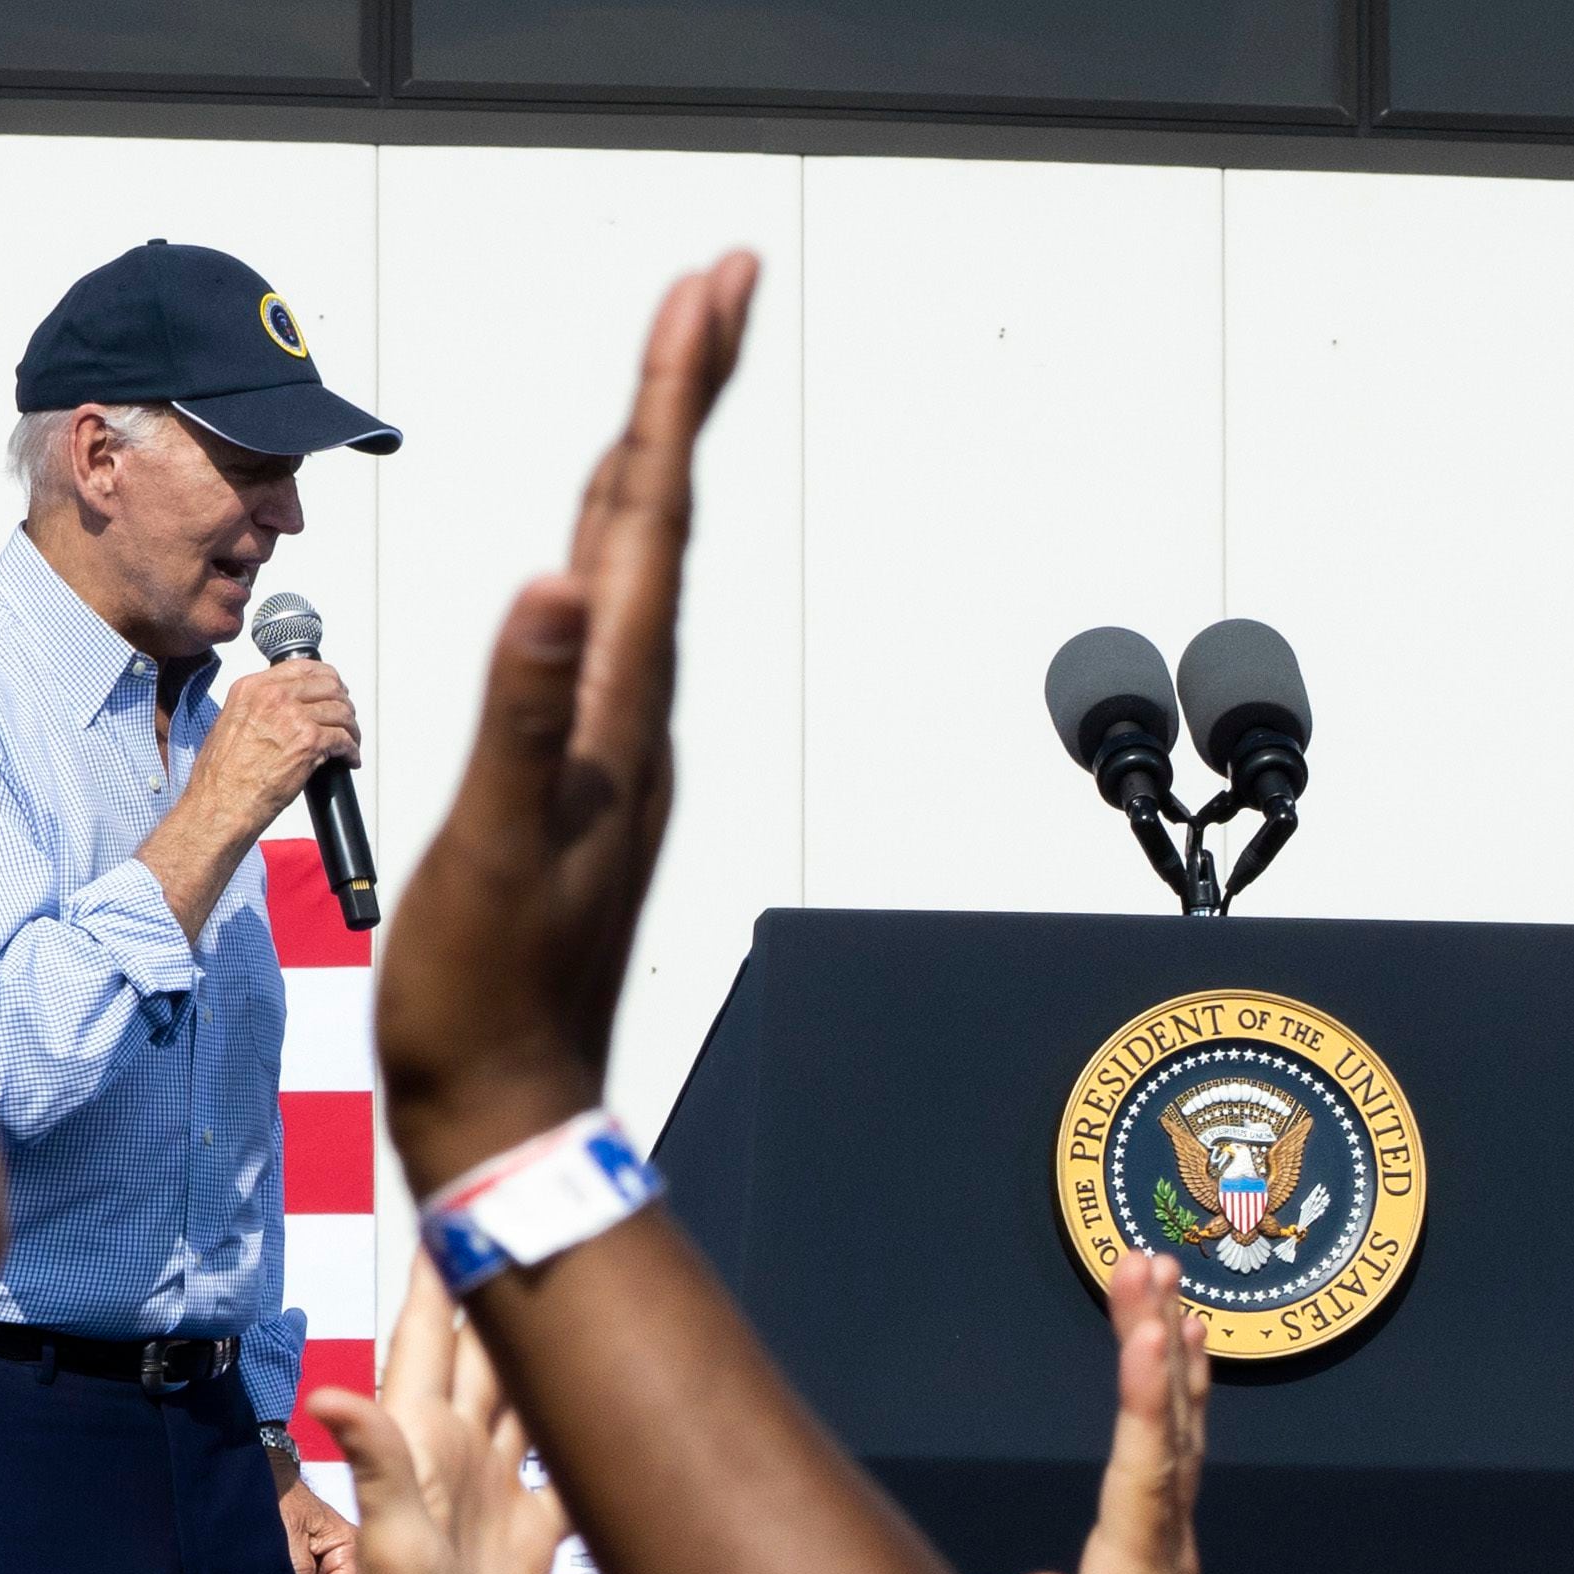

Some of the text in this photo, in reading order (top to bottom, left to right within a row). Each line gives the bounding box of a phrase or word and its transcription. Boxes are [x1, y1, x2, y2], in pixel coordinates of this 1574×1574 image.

[1070, 1004, 1413, 1342] OF THE PRESIDENT OF THE UNITED STATES
